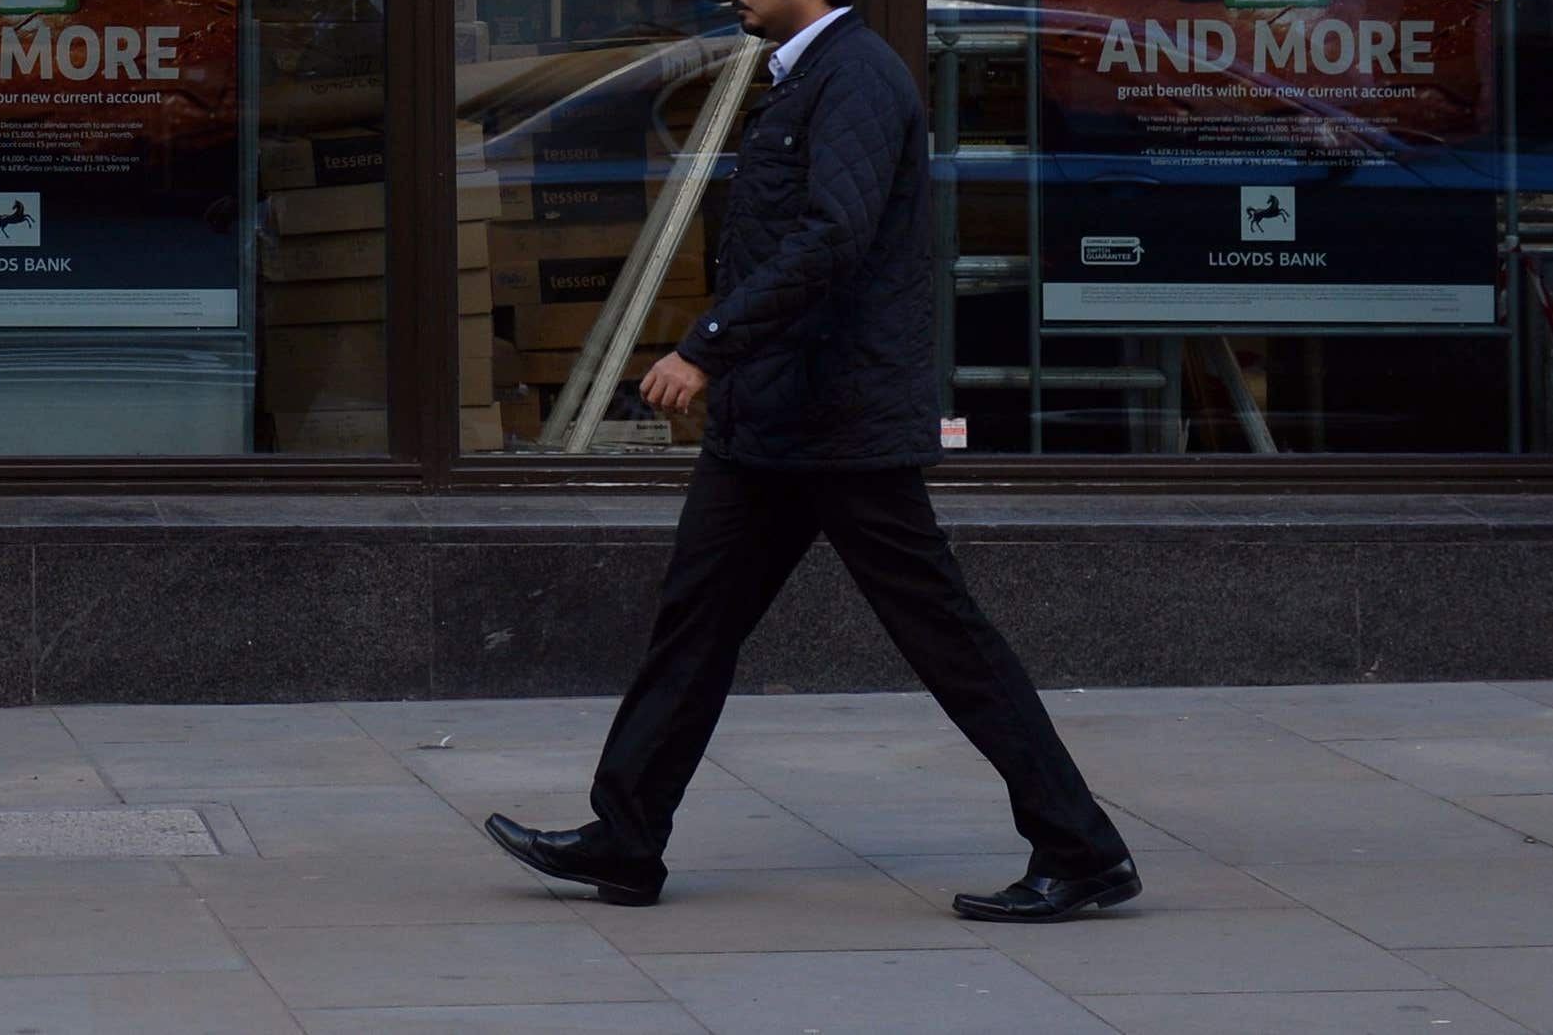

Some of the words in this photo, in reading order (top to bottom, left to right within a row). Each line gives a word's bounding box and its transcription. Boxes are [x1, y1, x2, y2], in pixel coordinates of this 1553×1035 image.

[0, 25, 180, 80] MORE
[1096, 19, 1237, 74] AND
[1253, 19, 1434, 74] MORE
[21, 94, 50, 105] new
[53, 92, 102, 105] current
[104, 92, 161, 105] account
[1117, 85, 1154, 102] great
[1156, 83, 1213, 99] benefits
[1216, 83, 1247, 99] with
[1250, 87, 1273, 99] our
[1275, 87, 1305, 99] new
[1307, 85, 1357, 99] current
[1359, 85, 1416, 99] account
[324, 154, 383, 169] tessera
[542, 188, 599, 205] tessera
[24, 257, 72, 272] BANK
[1209, 252, 1274, 266] LLOYDS
[1279, 252, 1327, 266] BANK
[550, 273, 609, 289] tessera
